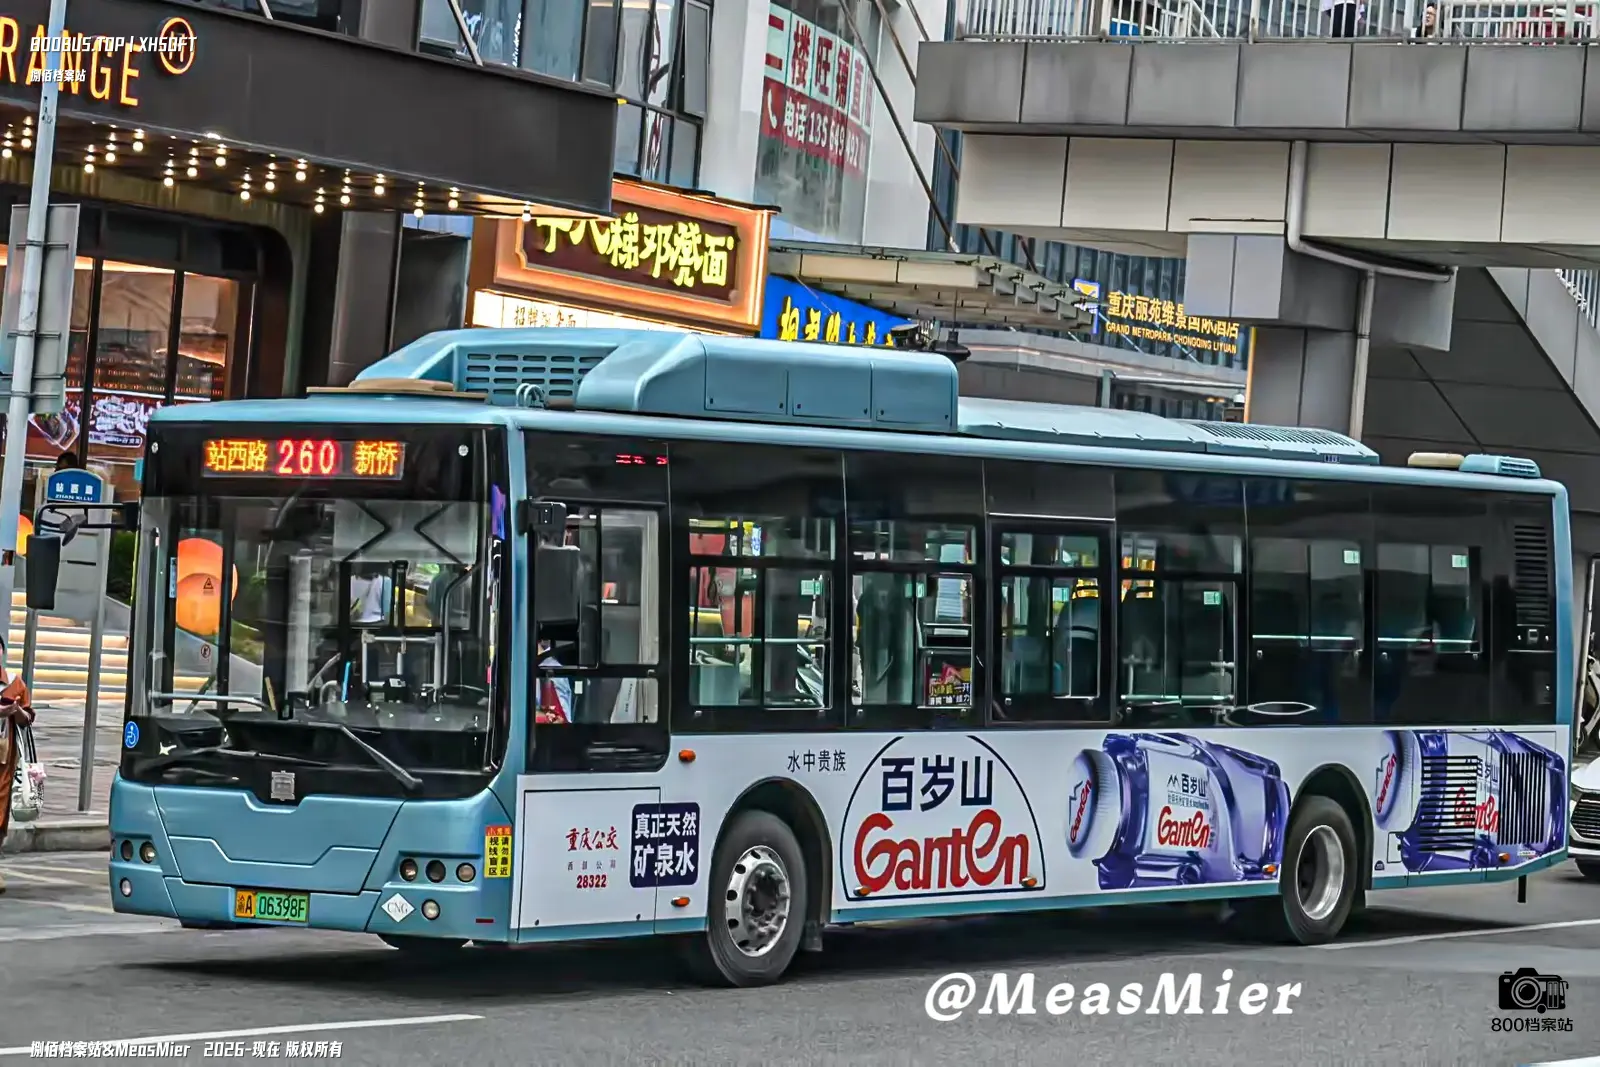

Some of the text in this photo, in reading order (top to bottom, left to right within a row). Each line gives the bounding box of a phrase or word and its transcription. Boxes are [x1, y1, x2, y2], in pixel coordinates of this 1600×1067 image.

[1105, 321, 1130, 334] GRAND
[207, 440, 399, 475] 站西路 260 新桥
[787, 749, 847, 773] 水中贵族
[881, 755, 993, 812] 百岁山
[1181, 773, 1206, 797] 百岁山
[635, 811, 697, 839] 真正天然
[1158, 806, 1210, 848] Ganten
[566, 826, 618, 851] 重庆公交
[854, 808, 1029, 893] Ganten
[633, 842, 696, 878] 矿泉水
[576, 874, 607, 889] 28322
[386, 901, 409, 915] CNG
